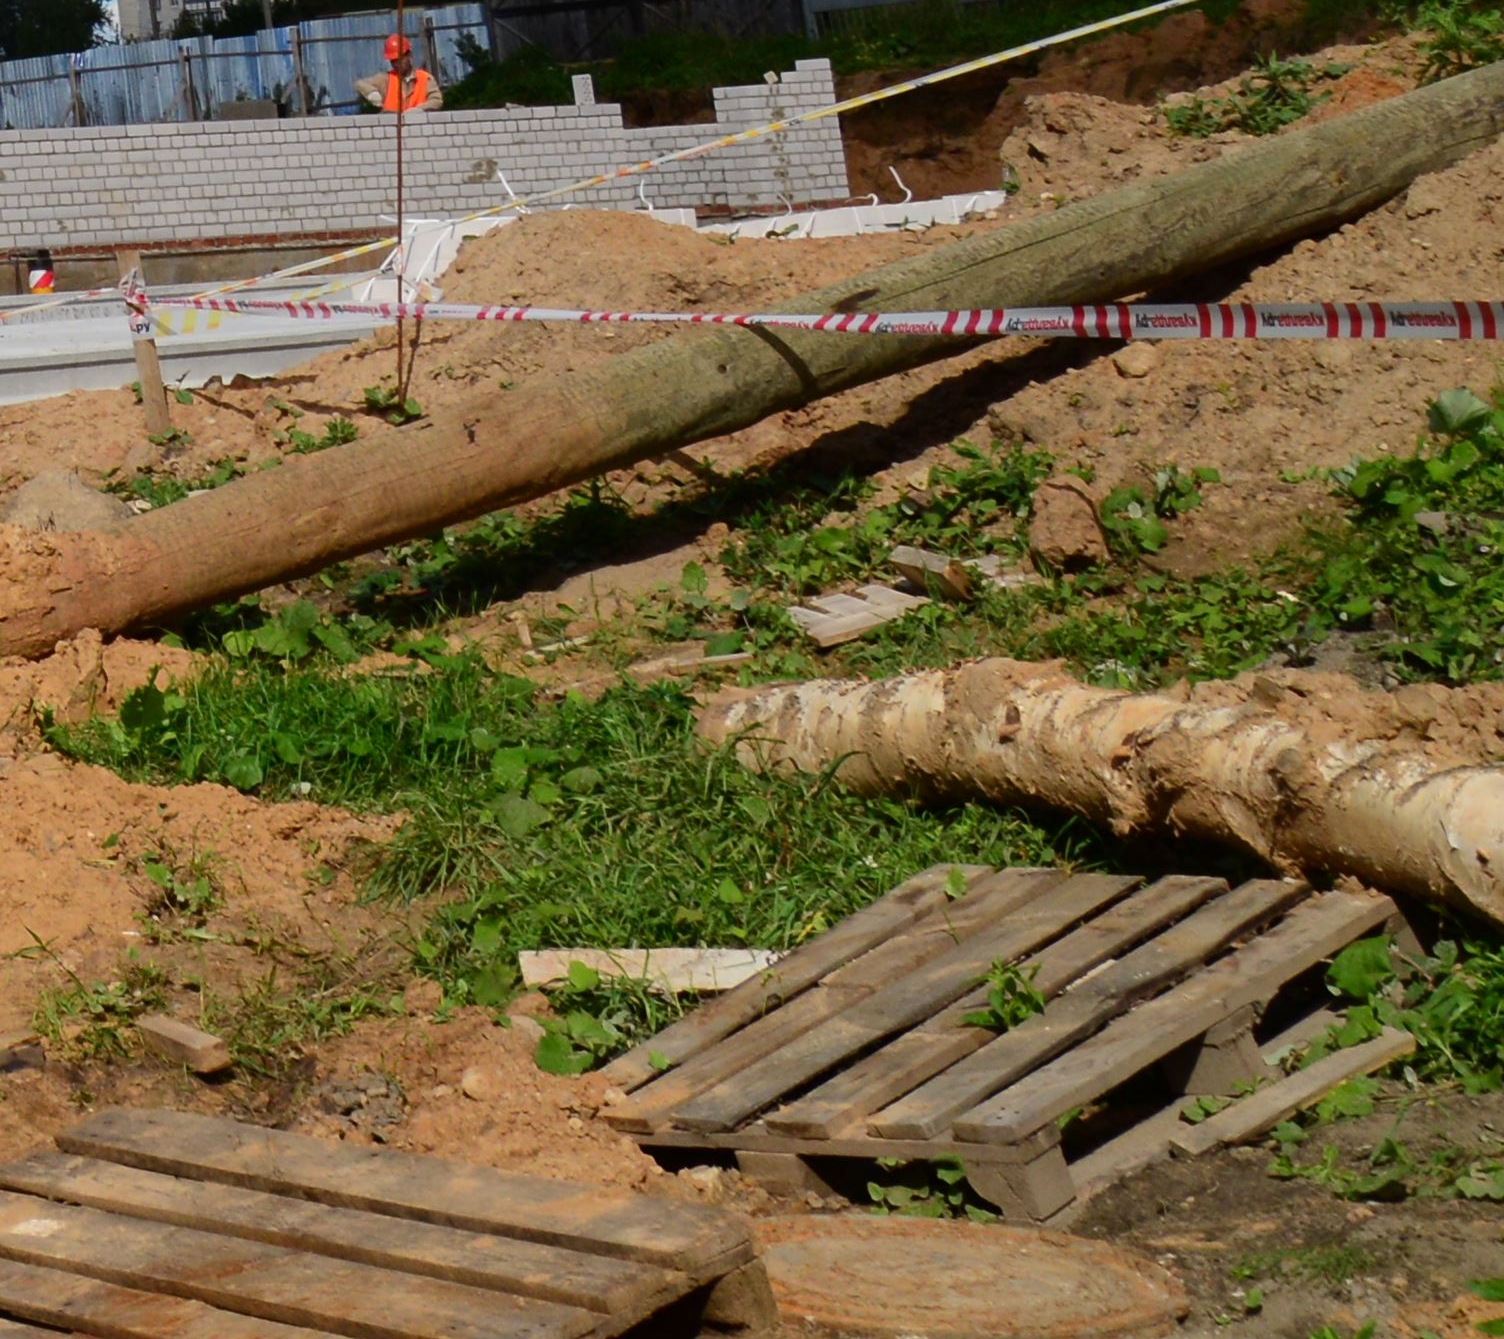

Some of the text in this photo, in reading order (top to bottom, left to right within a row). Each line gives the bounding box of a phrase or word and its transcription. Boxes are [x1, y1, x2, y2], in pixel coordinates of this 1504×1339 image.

[1006, 317, 1071, 331] кувалда.ру
[1135, 313, 1198, 328] кувалда.ру
[1261, 313, 1324, 328] кувалда.ру
[1390, 311, 1457, 327] кувалда.ру
